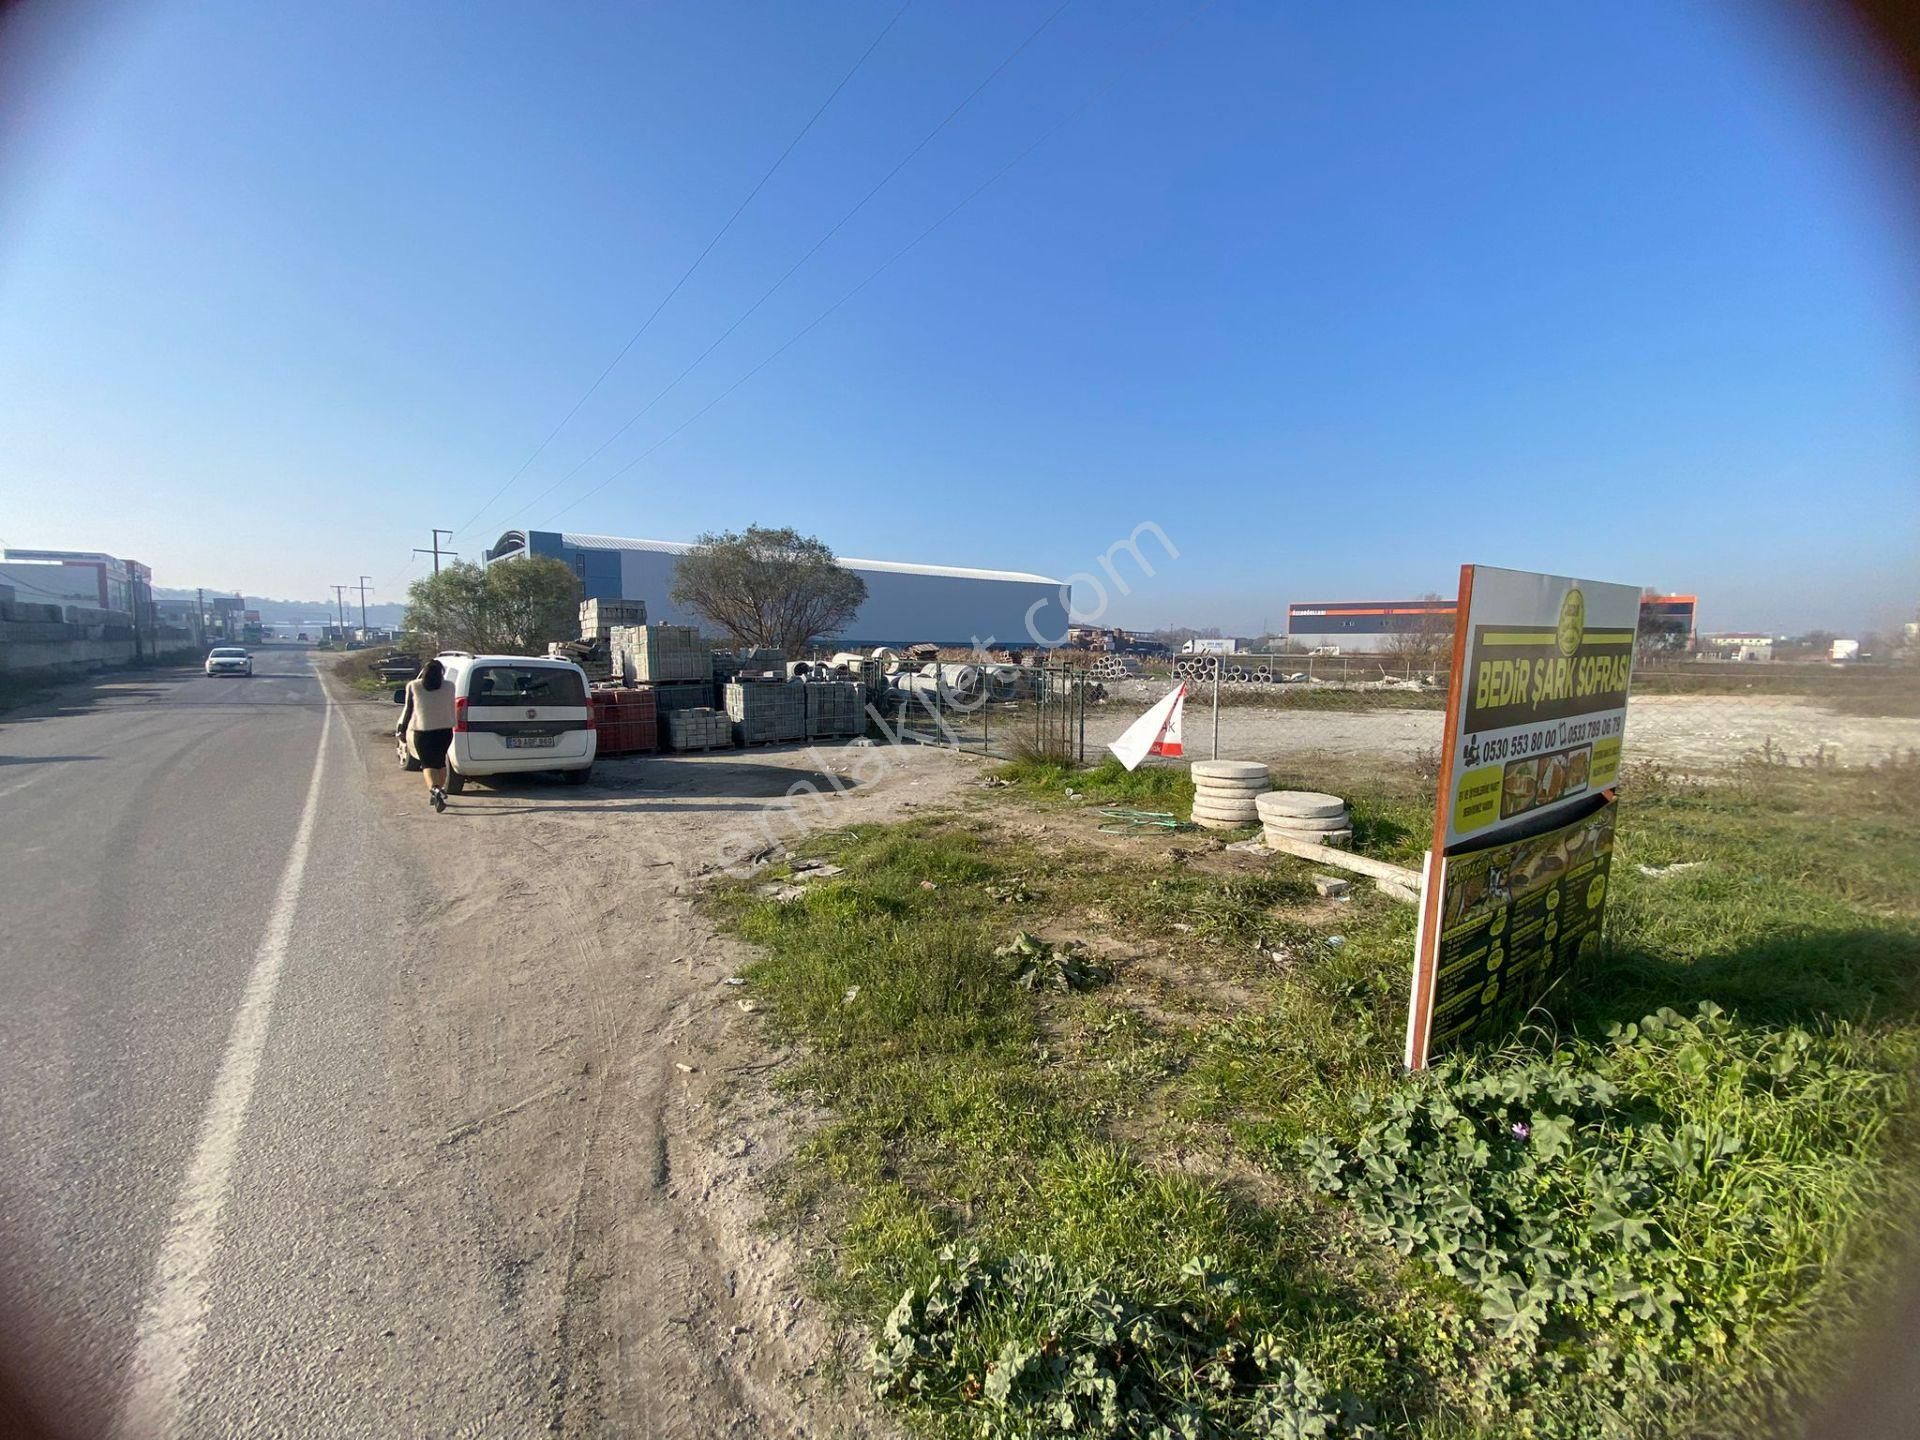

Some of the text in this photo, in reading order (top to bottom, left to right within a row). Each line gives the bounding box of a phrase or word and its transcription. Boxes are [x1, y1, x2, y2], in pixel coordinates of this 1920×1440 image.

[1532, 657, 1577, 711] ŞARK
[1576, 655, 1630, 697] SOFRASI
[1483, 737, 1509, 762] 0530
[1511, 734, 1529, 757] 553
[1530, 731, 1543, 751] 80
[1544, 729, 1557, 747] 00
